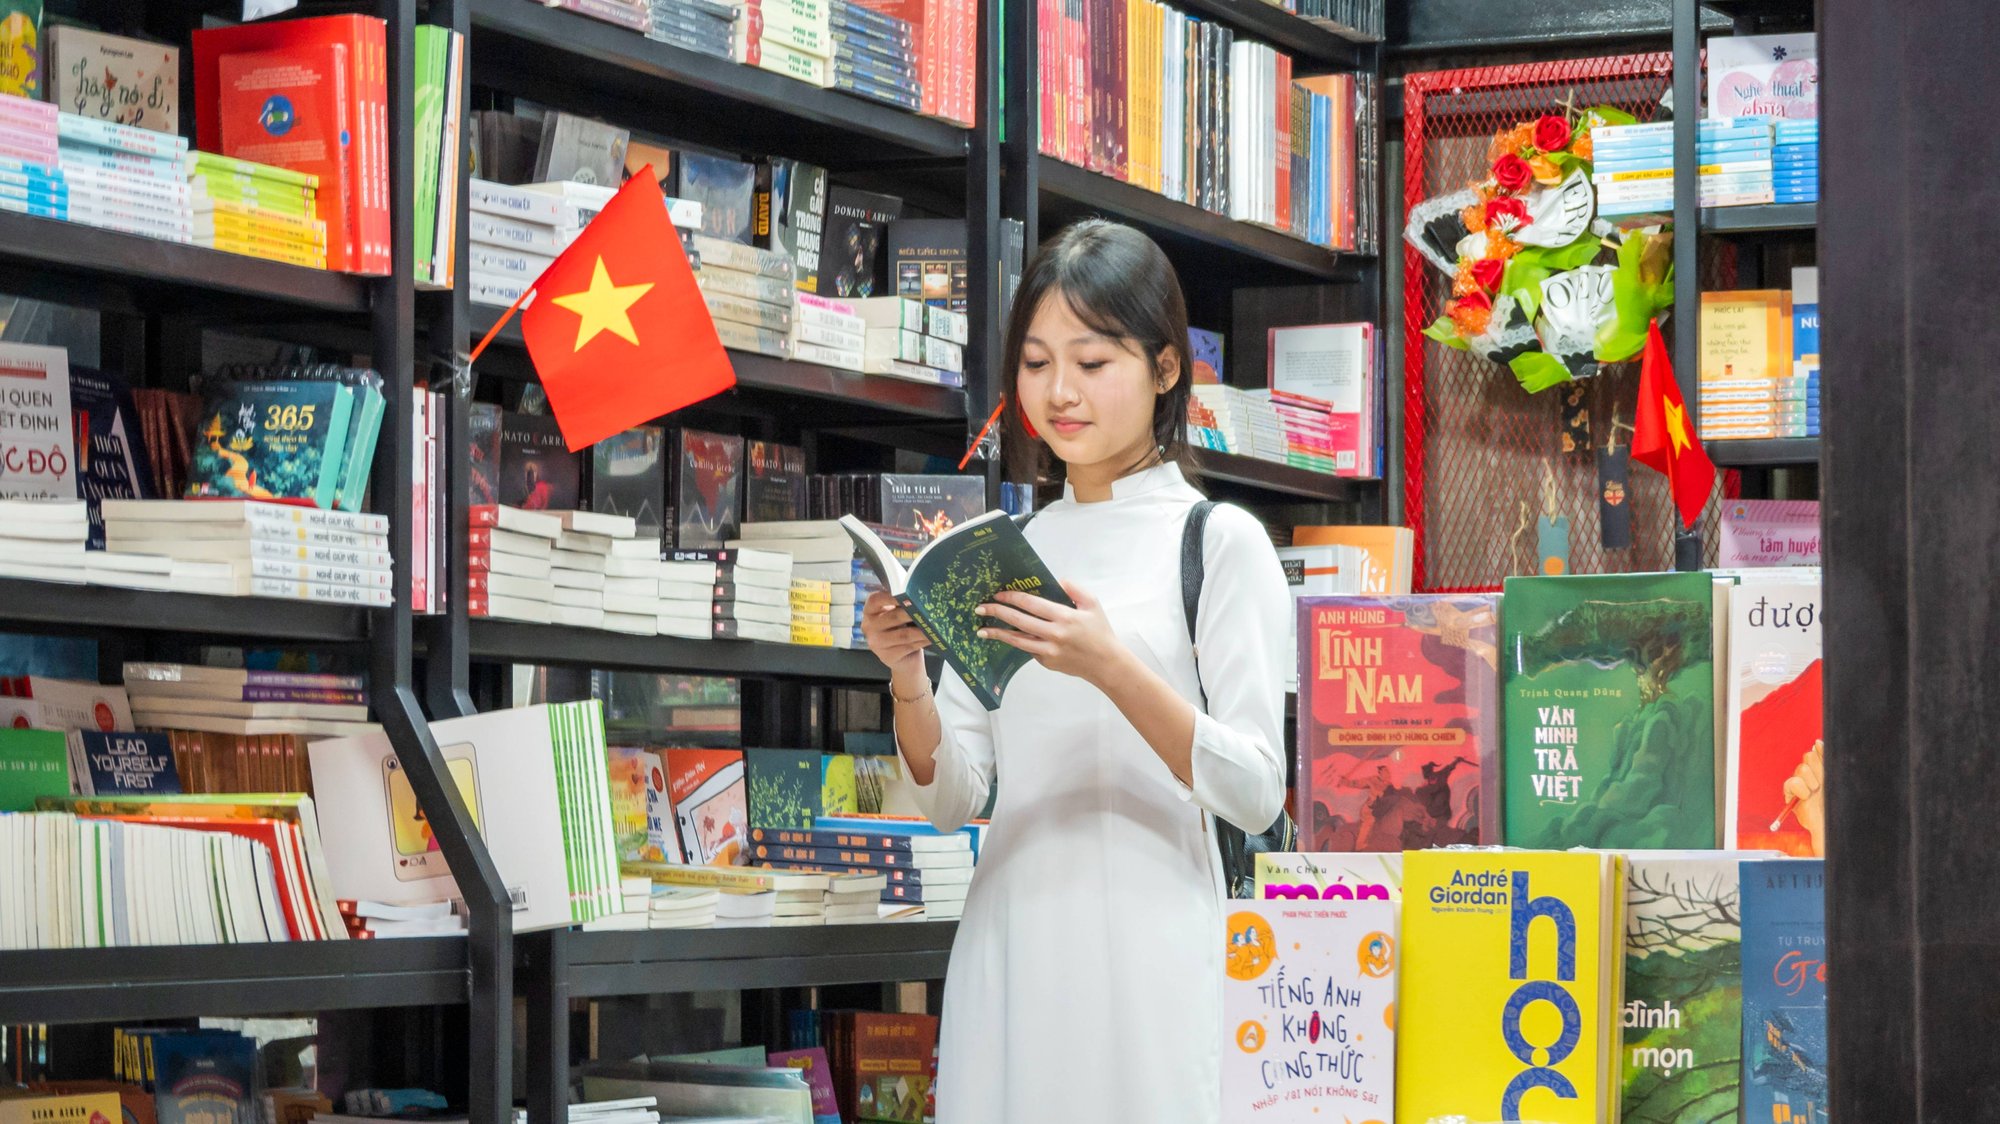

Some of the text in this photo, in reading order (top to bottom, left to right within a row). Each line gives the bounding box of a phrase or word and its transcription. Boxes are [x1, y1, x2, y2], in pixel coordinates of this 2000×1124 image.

[9, 389, 53, 408] QUEN
[264, 404, 316, 432] 365
[1318, 607, 1385, 624] ANH HÙNG
[1749, 596, 1824, 633] đượ
[1345, 667, 1422, 714] NAM
[1554, 689, 1588, 699] Quang
[1538, 705, 1575, 726] VĂN
[1535, 727, 1578, 744] MINH
[105, 736, 147, 755] LEAD
[92, 754, 168, 772] YOURSELF
[114, 773, 155, 788] FIRST
[1531, 771, 1583, 801] VIỆT
[1450, 869, 1508, 887] André
[1430, 886, 1507, 905] Giordan
[1258, 965, 1361, 1009] TIẾNG ANH
[1283, 1010, 1347, 1044] KHÔNG
[1316, 1045, 1364, 1083] THỨC
[1632, 1047, 1694, 1077] mọn
[1326, 1085, 1358, 1099] KHÔNG
